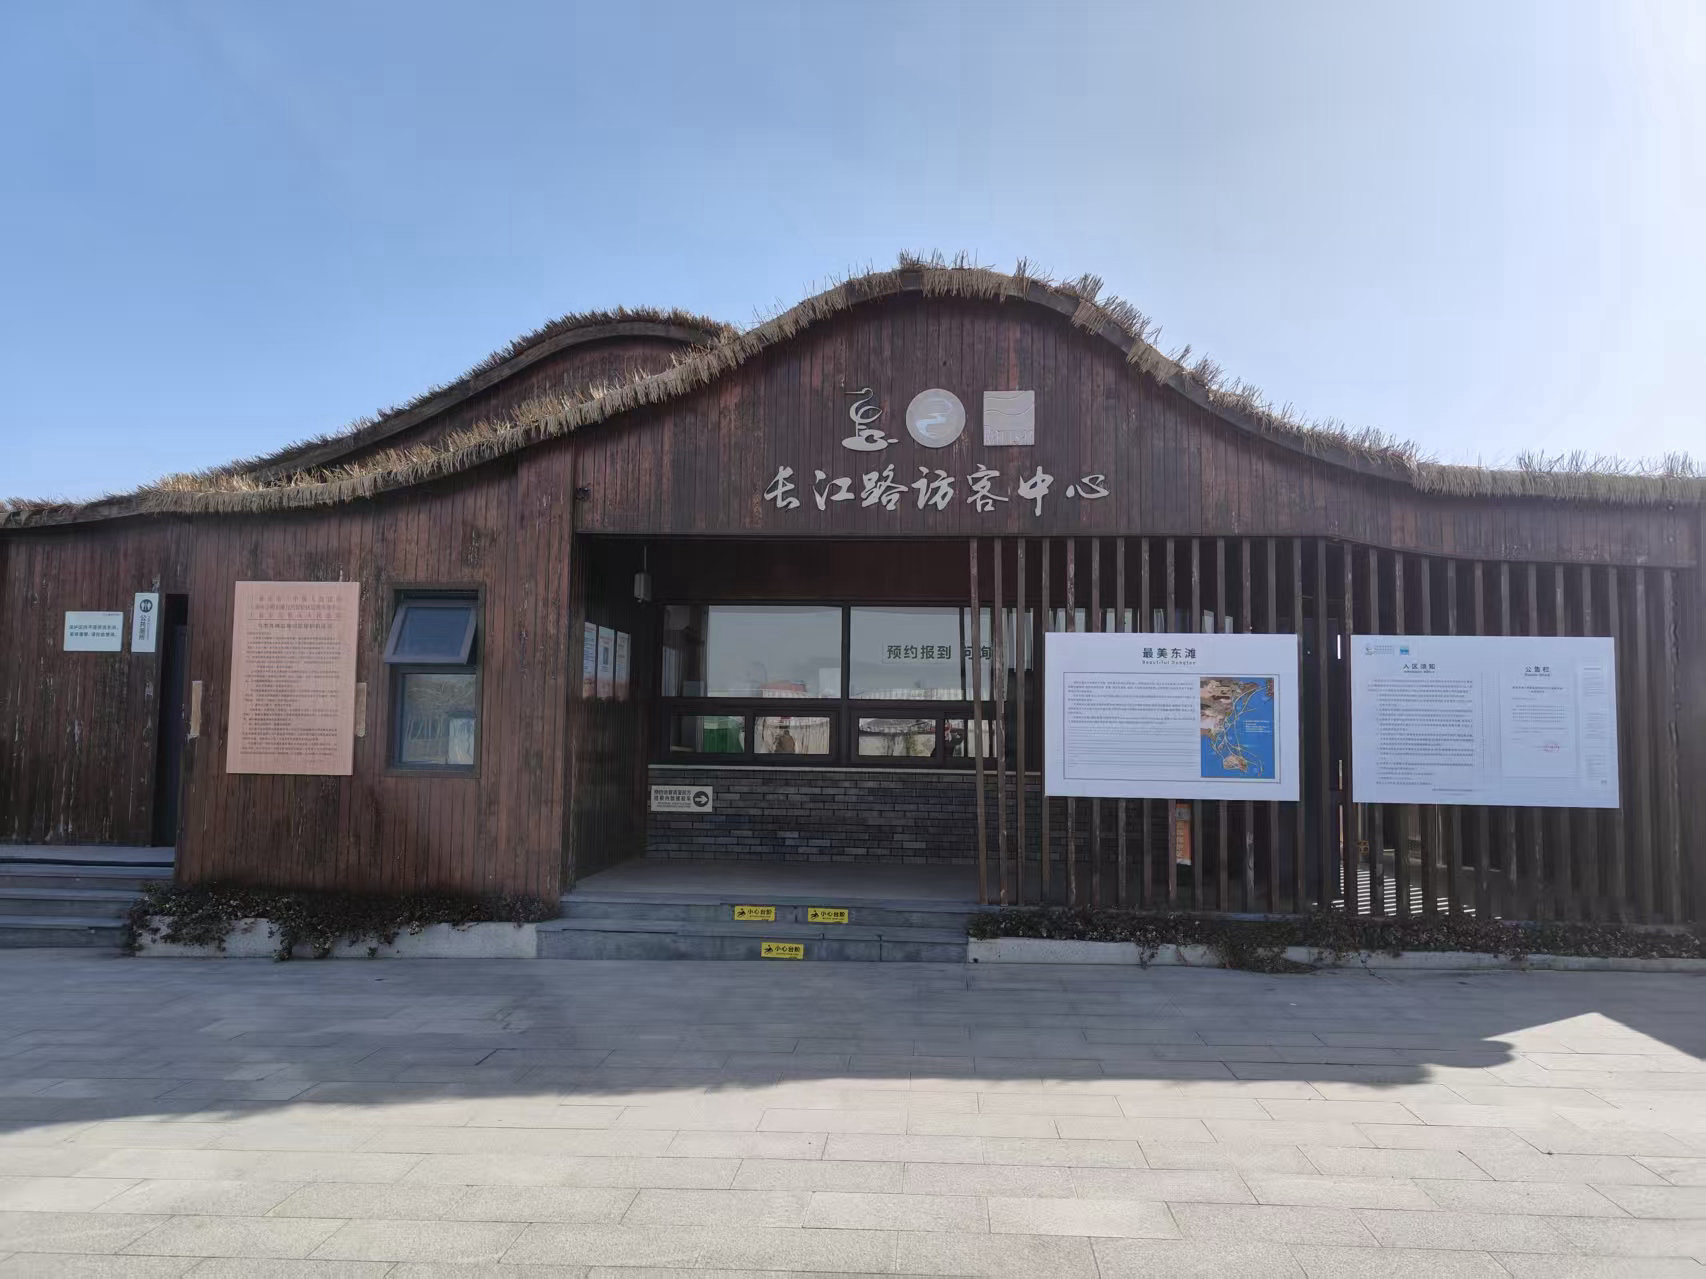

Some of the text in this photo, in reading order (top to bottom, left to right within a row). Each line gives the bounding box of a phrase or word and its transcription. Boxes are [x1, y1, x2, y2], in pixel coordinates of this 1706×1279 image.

[763, 463, 1110, 516] 长江路访客中心
[887, 645, 952, 660] 预约报到
[1142, 647, 1197, 659] 最美东滩
